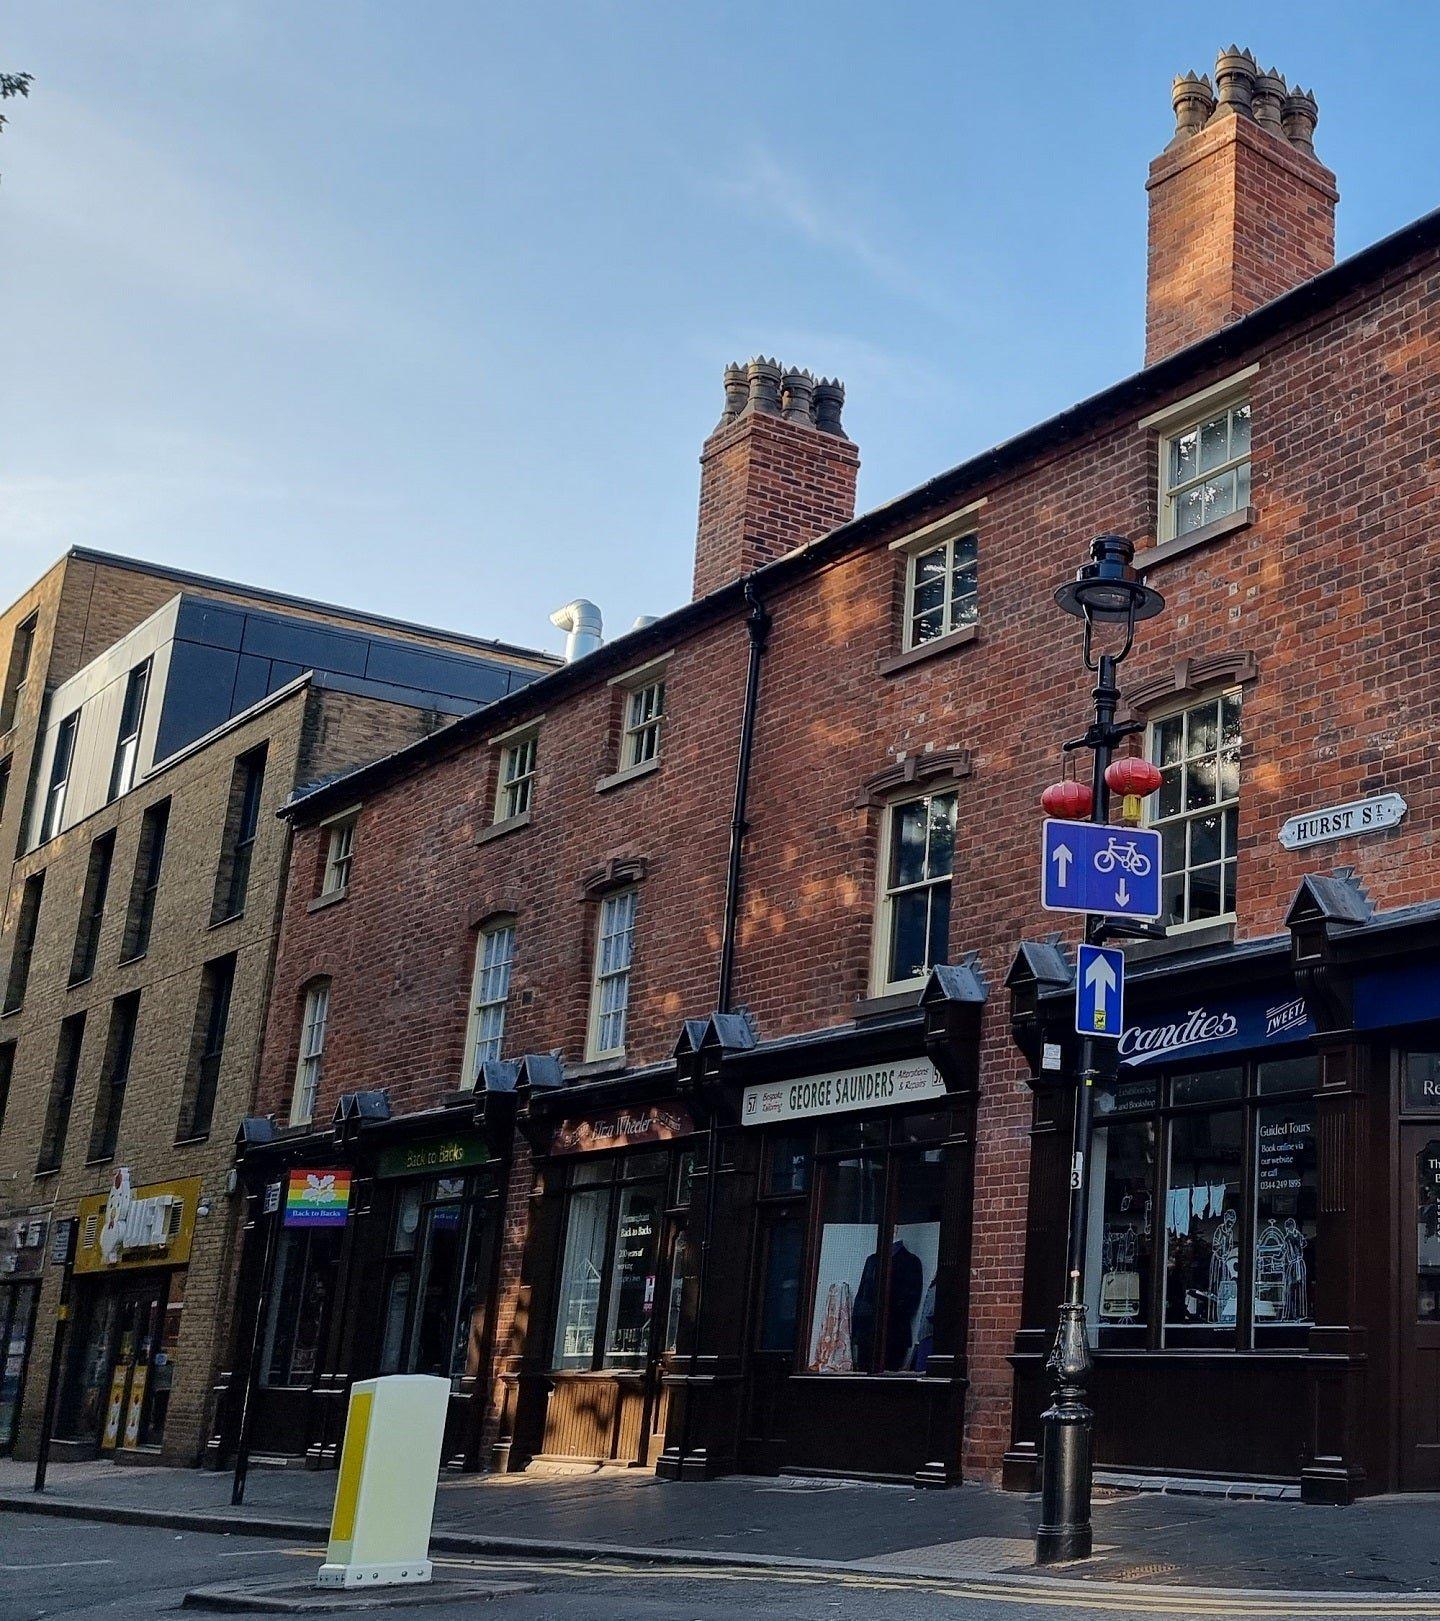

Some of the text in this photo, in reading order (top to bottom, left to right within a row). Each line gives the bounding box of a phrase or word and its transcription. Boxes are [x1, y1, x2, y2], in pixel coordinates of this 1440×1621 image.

[1297, 811, 1354, 841] HURST
[1118, 1007, 1239, 1057] Candies
[789, 1070, 895, 1111] GEORGE SAUNDERS
[906, 1080, 927, 1092] Repairs
[748, 1097, 757, 1112] 57
[1260, 1122, 1311, 1137] Guided Tours
[1261, 1144, 1276, 1152] Book
[1260, 1180, 1275, 1189] 0344
[1276, 1180, 1287, 1188] 249
[292, 1208, 341, 1217] Back to Backs
